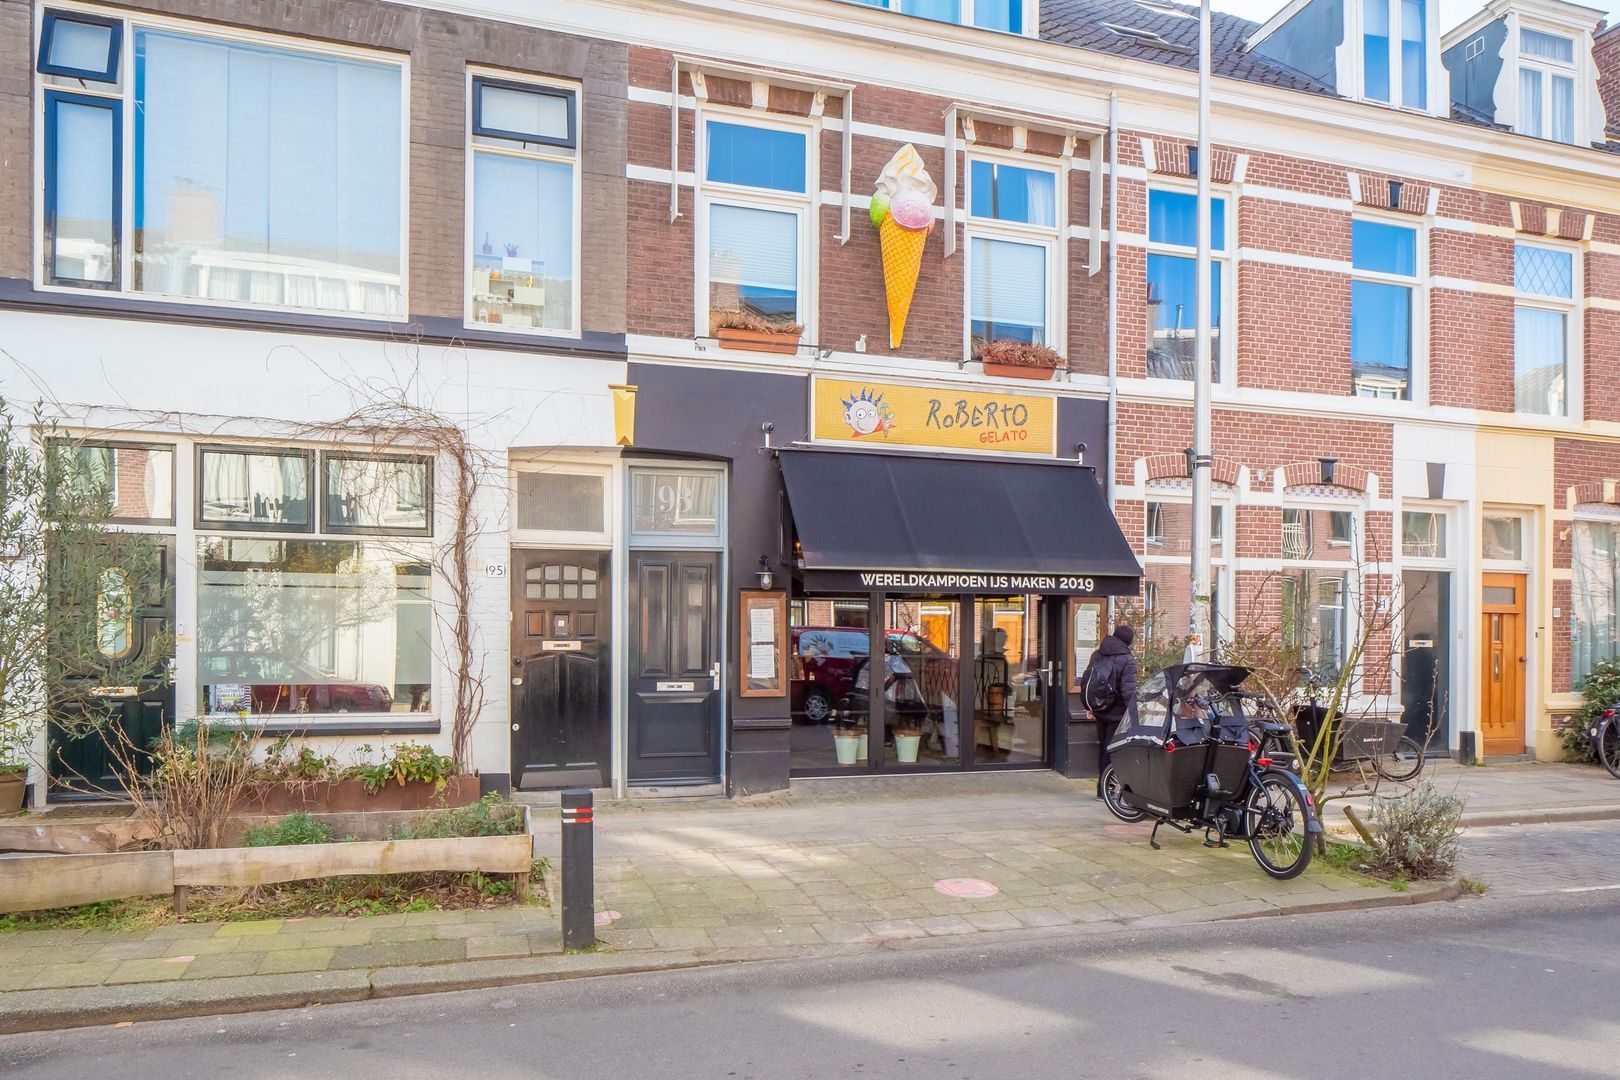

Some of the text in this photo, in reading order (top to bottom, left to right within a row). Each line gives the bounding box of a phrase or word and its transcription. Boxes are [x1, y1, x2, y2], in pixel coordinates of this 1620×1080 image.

[979, 430, 1028, 443] GELATO
[488, 564, 504, 576] 95
[861, 573, 1095, 592] WERELDKAMPIOEN IJS MAKEN 2019
